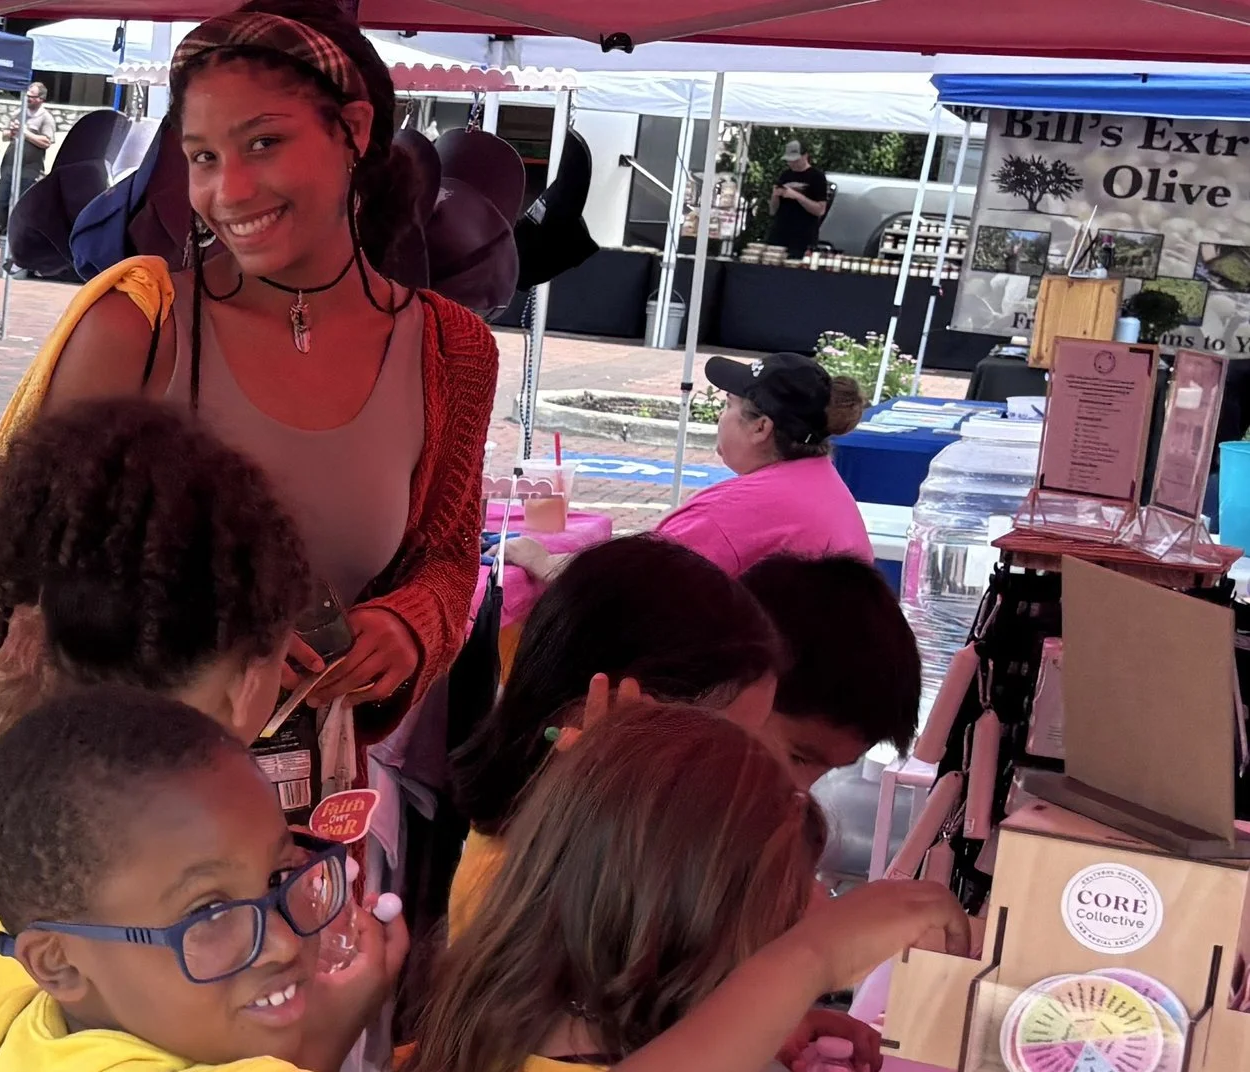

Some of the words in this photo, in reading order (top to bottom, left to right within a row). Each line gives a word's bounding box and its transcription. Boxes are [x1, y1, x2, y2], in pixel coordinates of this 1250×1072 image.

[1000, 109, 1123, 149] Bill's
[1137, 116, 1250, 157] Extr
[1102, 164, 1232, 209] Olive
[1204, 335, 1225, 351] to
[1077, 889, 1148, 915] CORE
[1076, 908, 1145, 929] Collective
